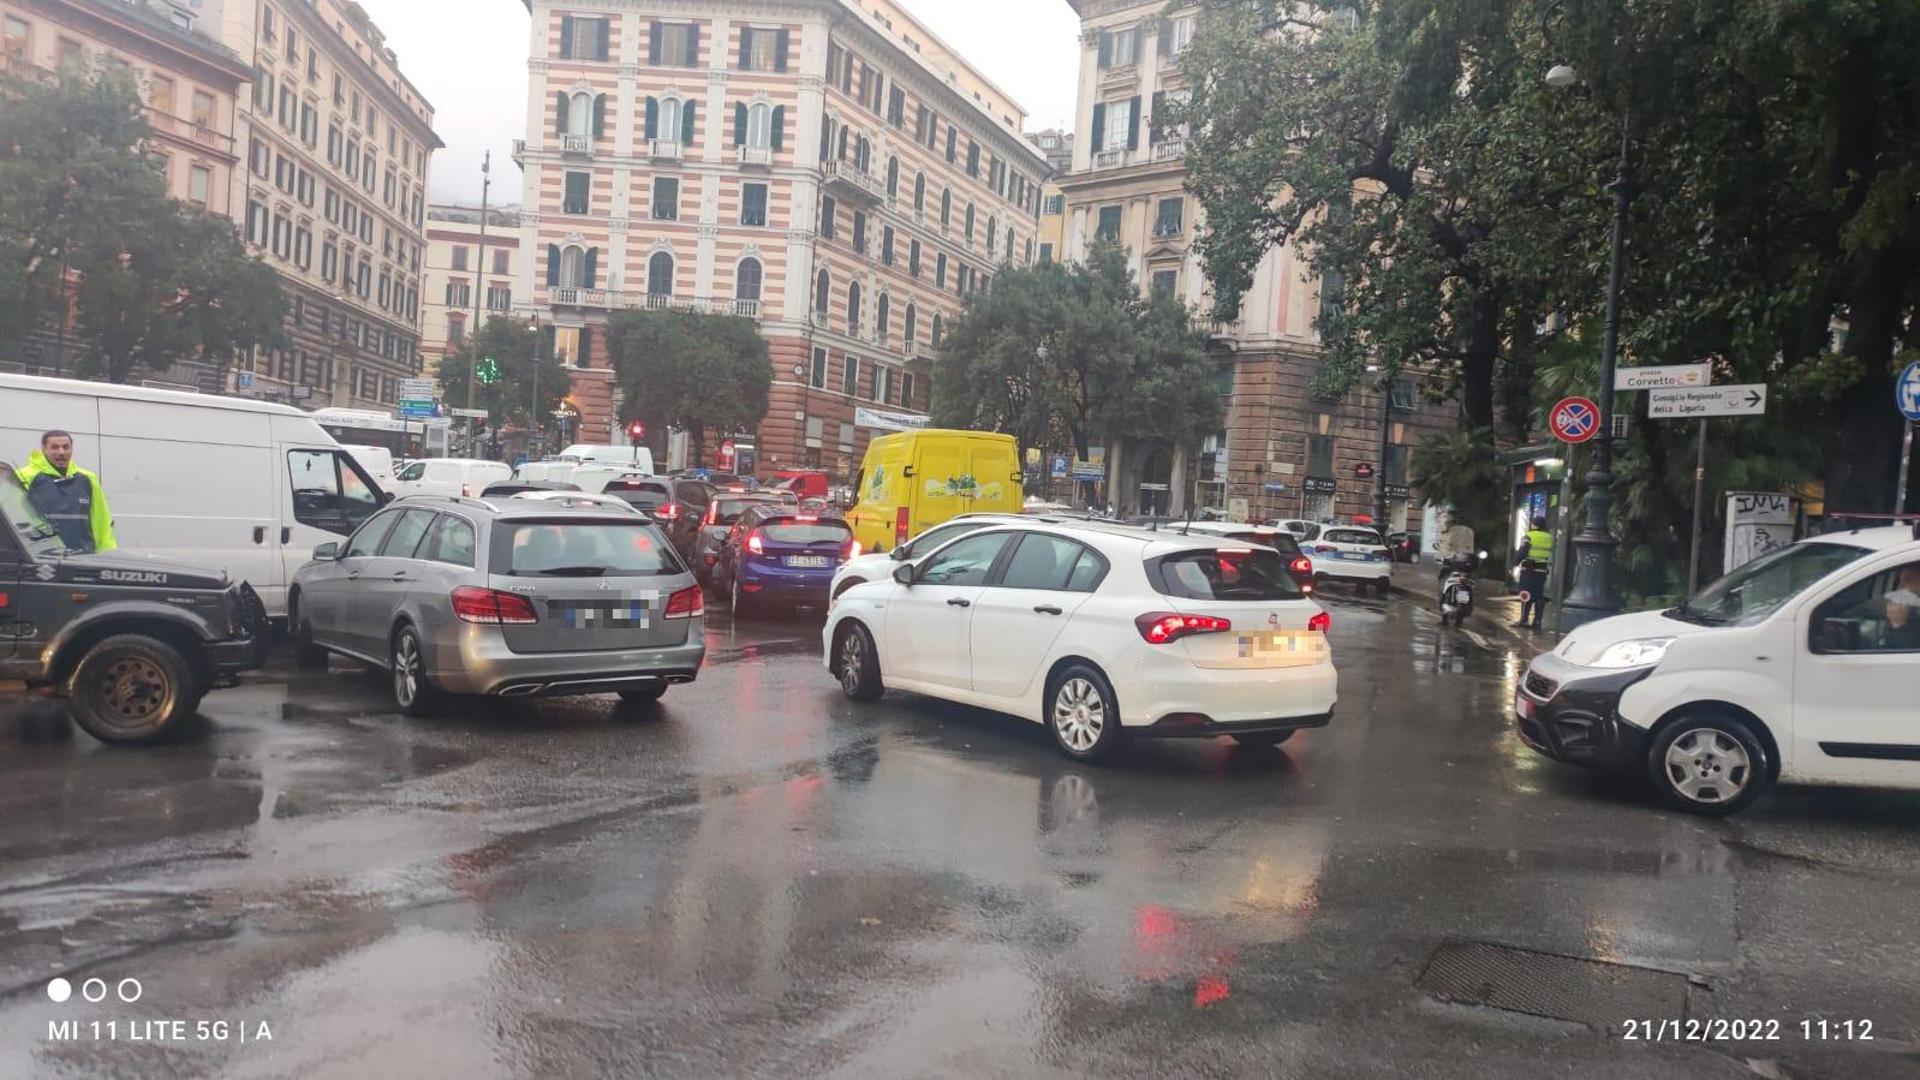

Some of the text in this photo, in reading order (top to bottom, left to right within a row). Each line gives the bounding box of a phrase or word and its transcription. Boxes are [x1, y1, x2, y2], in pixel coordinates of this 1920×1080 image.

[1628, 376, 1675, 386] Corvetto
[1653, 392, 1723, 403] Consiglio Regionale
[1679, 403, 1706, 413] Liguria
[100, 569, 168, 584] SUZUKI
